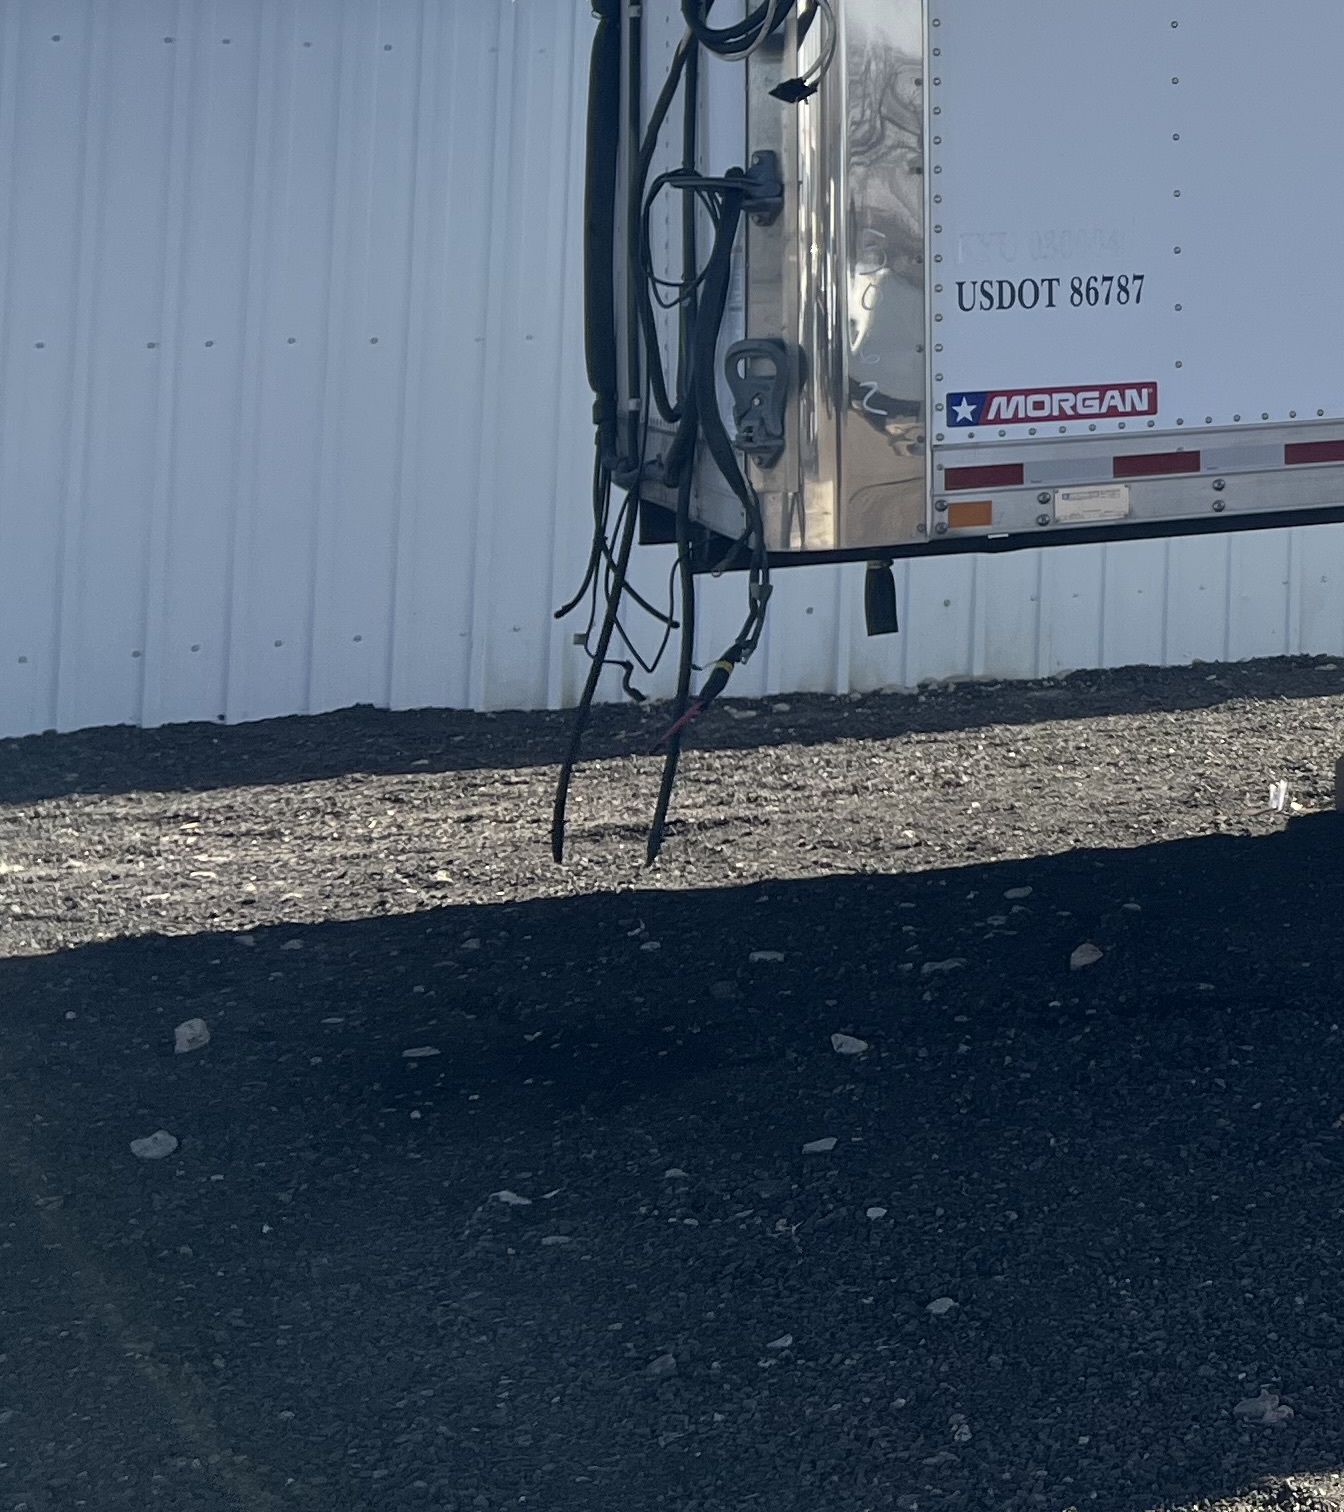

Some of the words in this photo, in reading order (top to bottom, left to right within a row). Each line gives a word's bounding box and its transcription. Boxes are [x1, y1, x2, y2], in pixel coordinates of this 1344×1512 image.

[955, 277, 1061, 312] USDOT
[1069, 273, 1146, 308] 86787
[986, 387, 1150, 421] MORGAN
